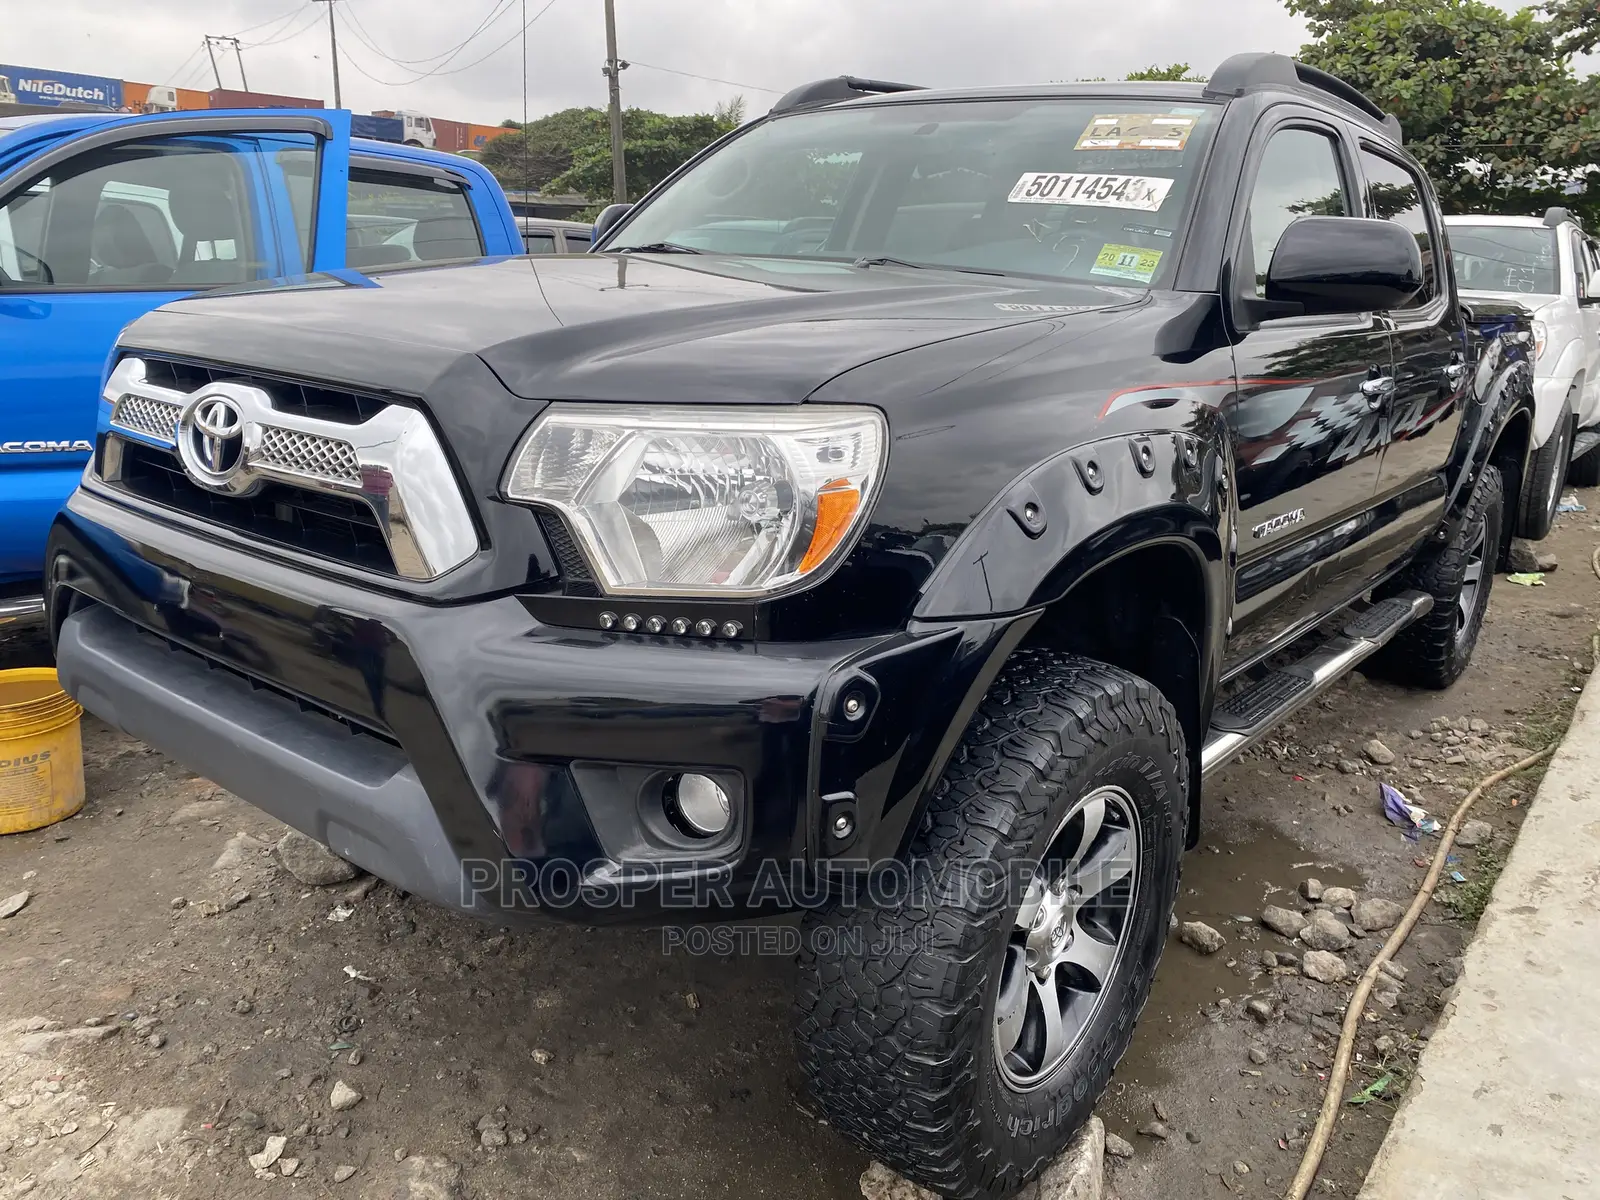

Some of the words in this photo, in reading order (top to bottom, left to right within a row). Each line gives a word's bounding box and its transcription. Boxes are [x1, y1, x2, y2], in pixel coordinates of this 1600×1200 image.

[18, 79, 104, 101] NileDutch
[1089, 126, 1184, 138] LAS
[1101, 252, 1116, 262] 20
[1118, 254, 1136, 268] 11
[1140, 259, 1156, 268] 23
[0, 440, 94, 453] COMA
